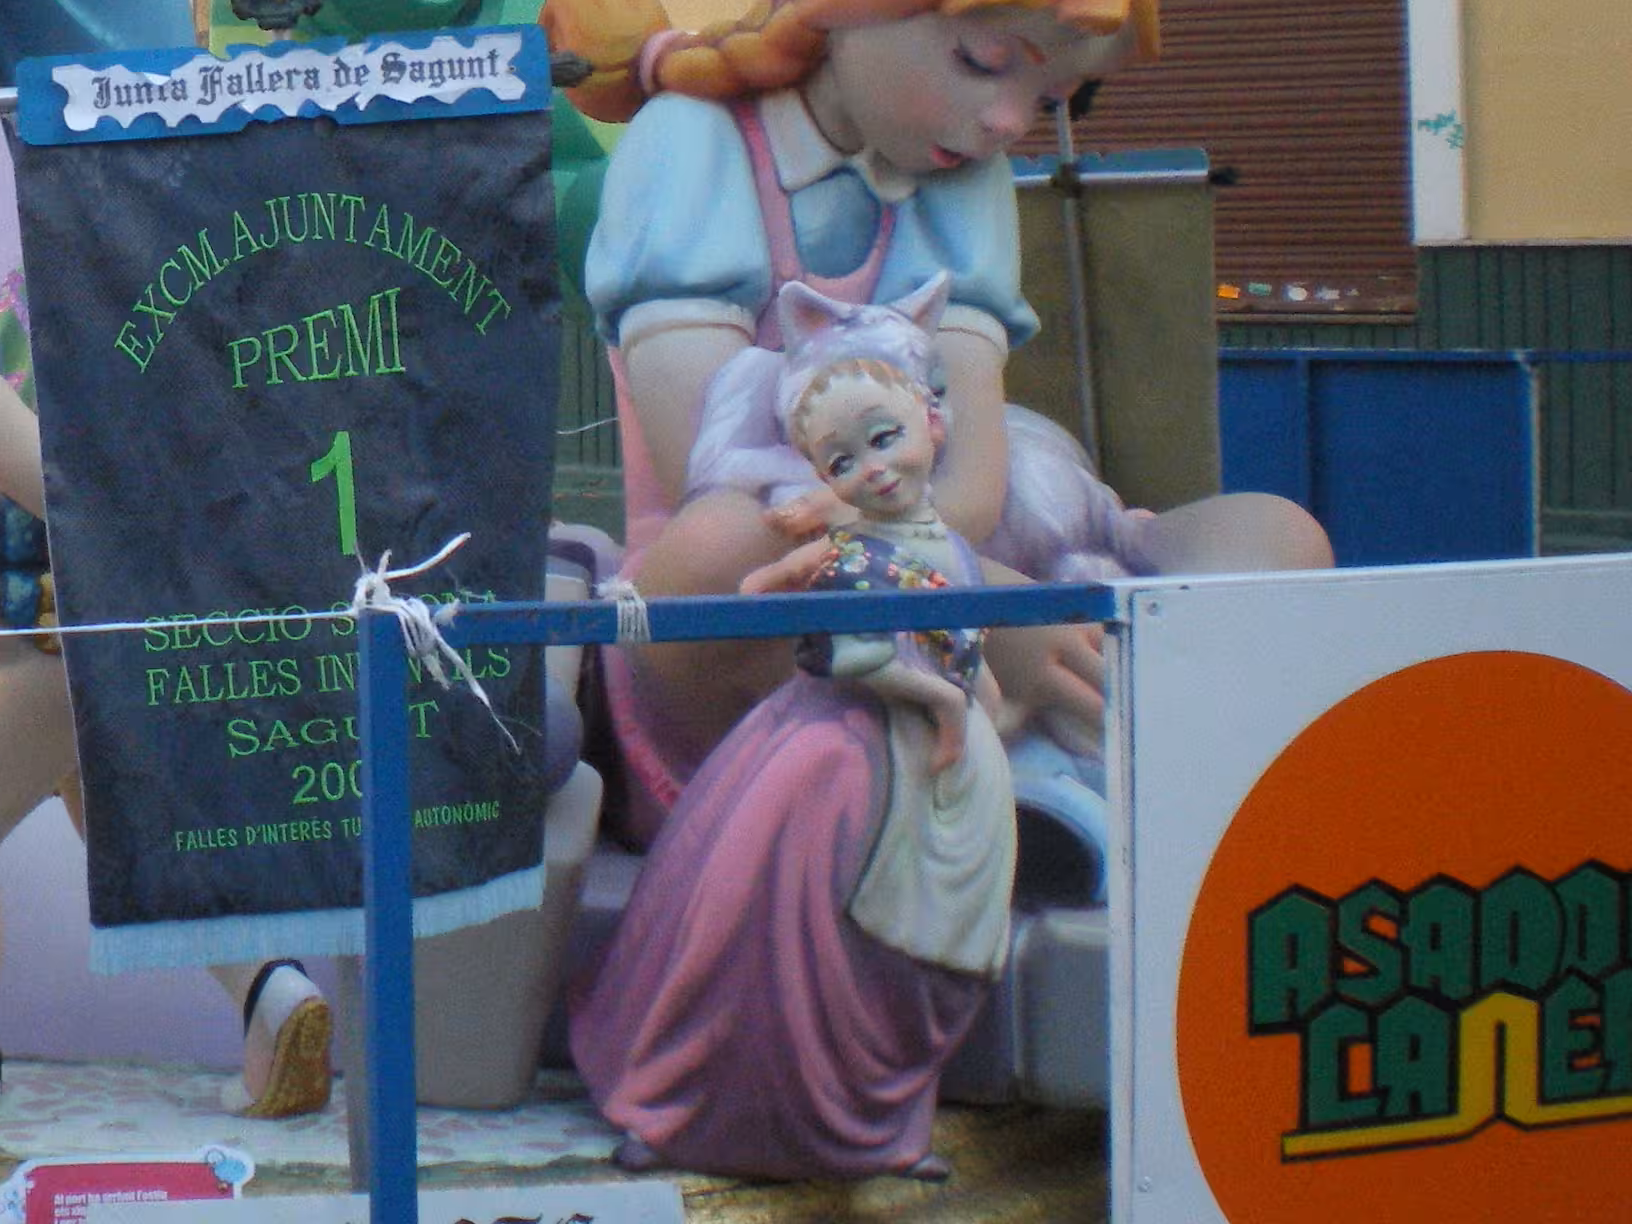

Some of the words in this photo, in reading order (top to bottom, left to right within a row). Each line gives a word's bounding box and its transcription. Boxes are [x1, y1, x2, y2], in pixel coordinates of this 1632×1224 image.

[91, 73, 189, 110] Junta
[197, 65, 321, 105] Fallera
[333, 56, 370, 88] de
[381, 47, 499, 89] Sagunt
[234, 192, 512, 336] AJUNTAMENT
[227, 287, 406, 389] PREMI
[309, 431, 356, 555] 1
[143, 604, 312, 652] SECCIO
[146, 658, 302, 706] FALLES
[175, 828, 239, 852] FALLES
[1247, 858, 1632, 1038] ASADO
